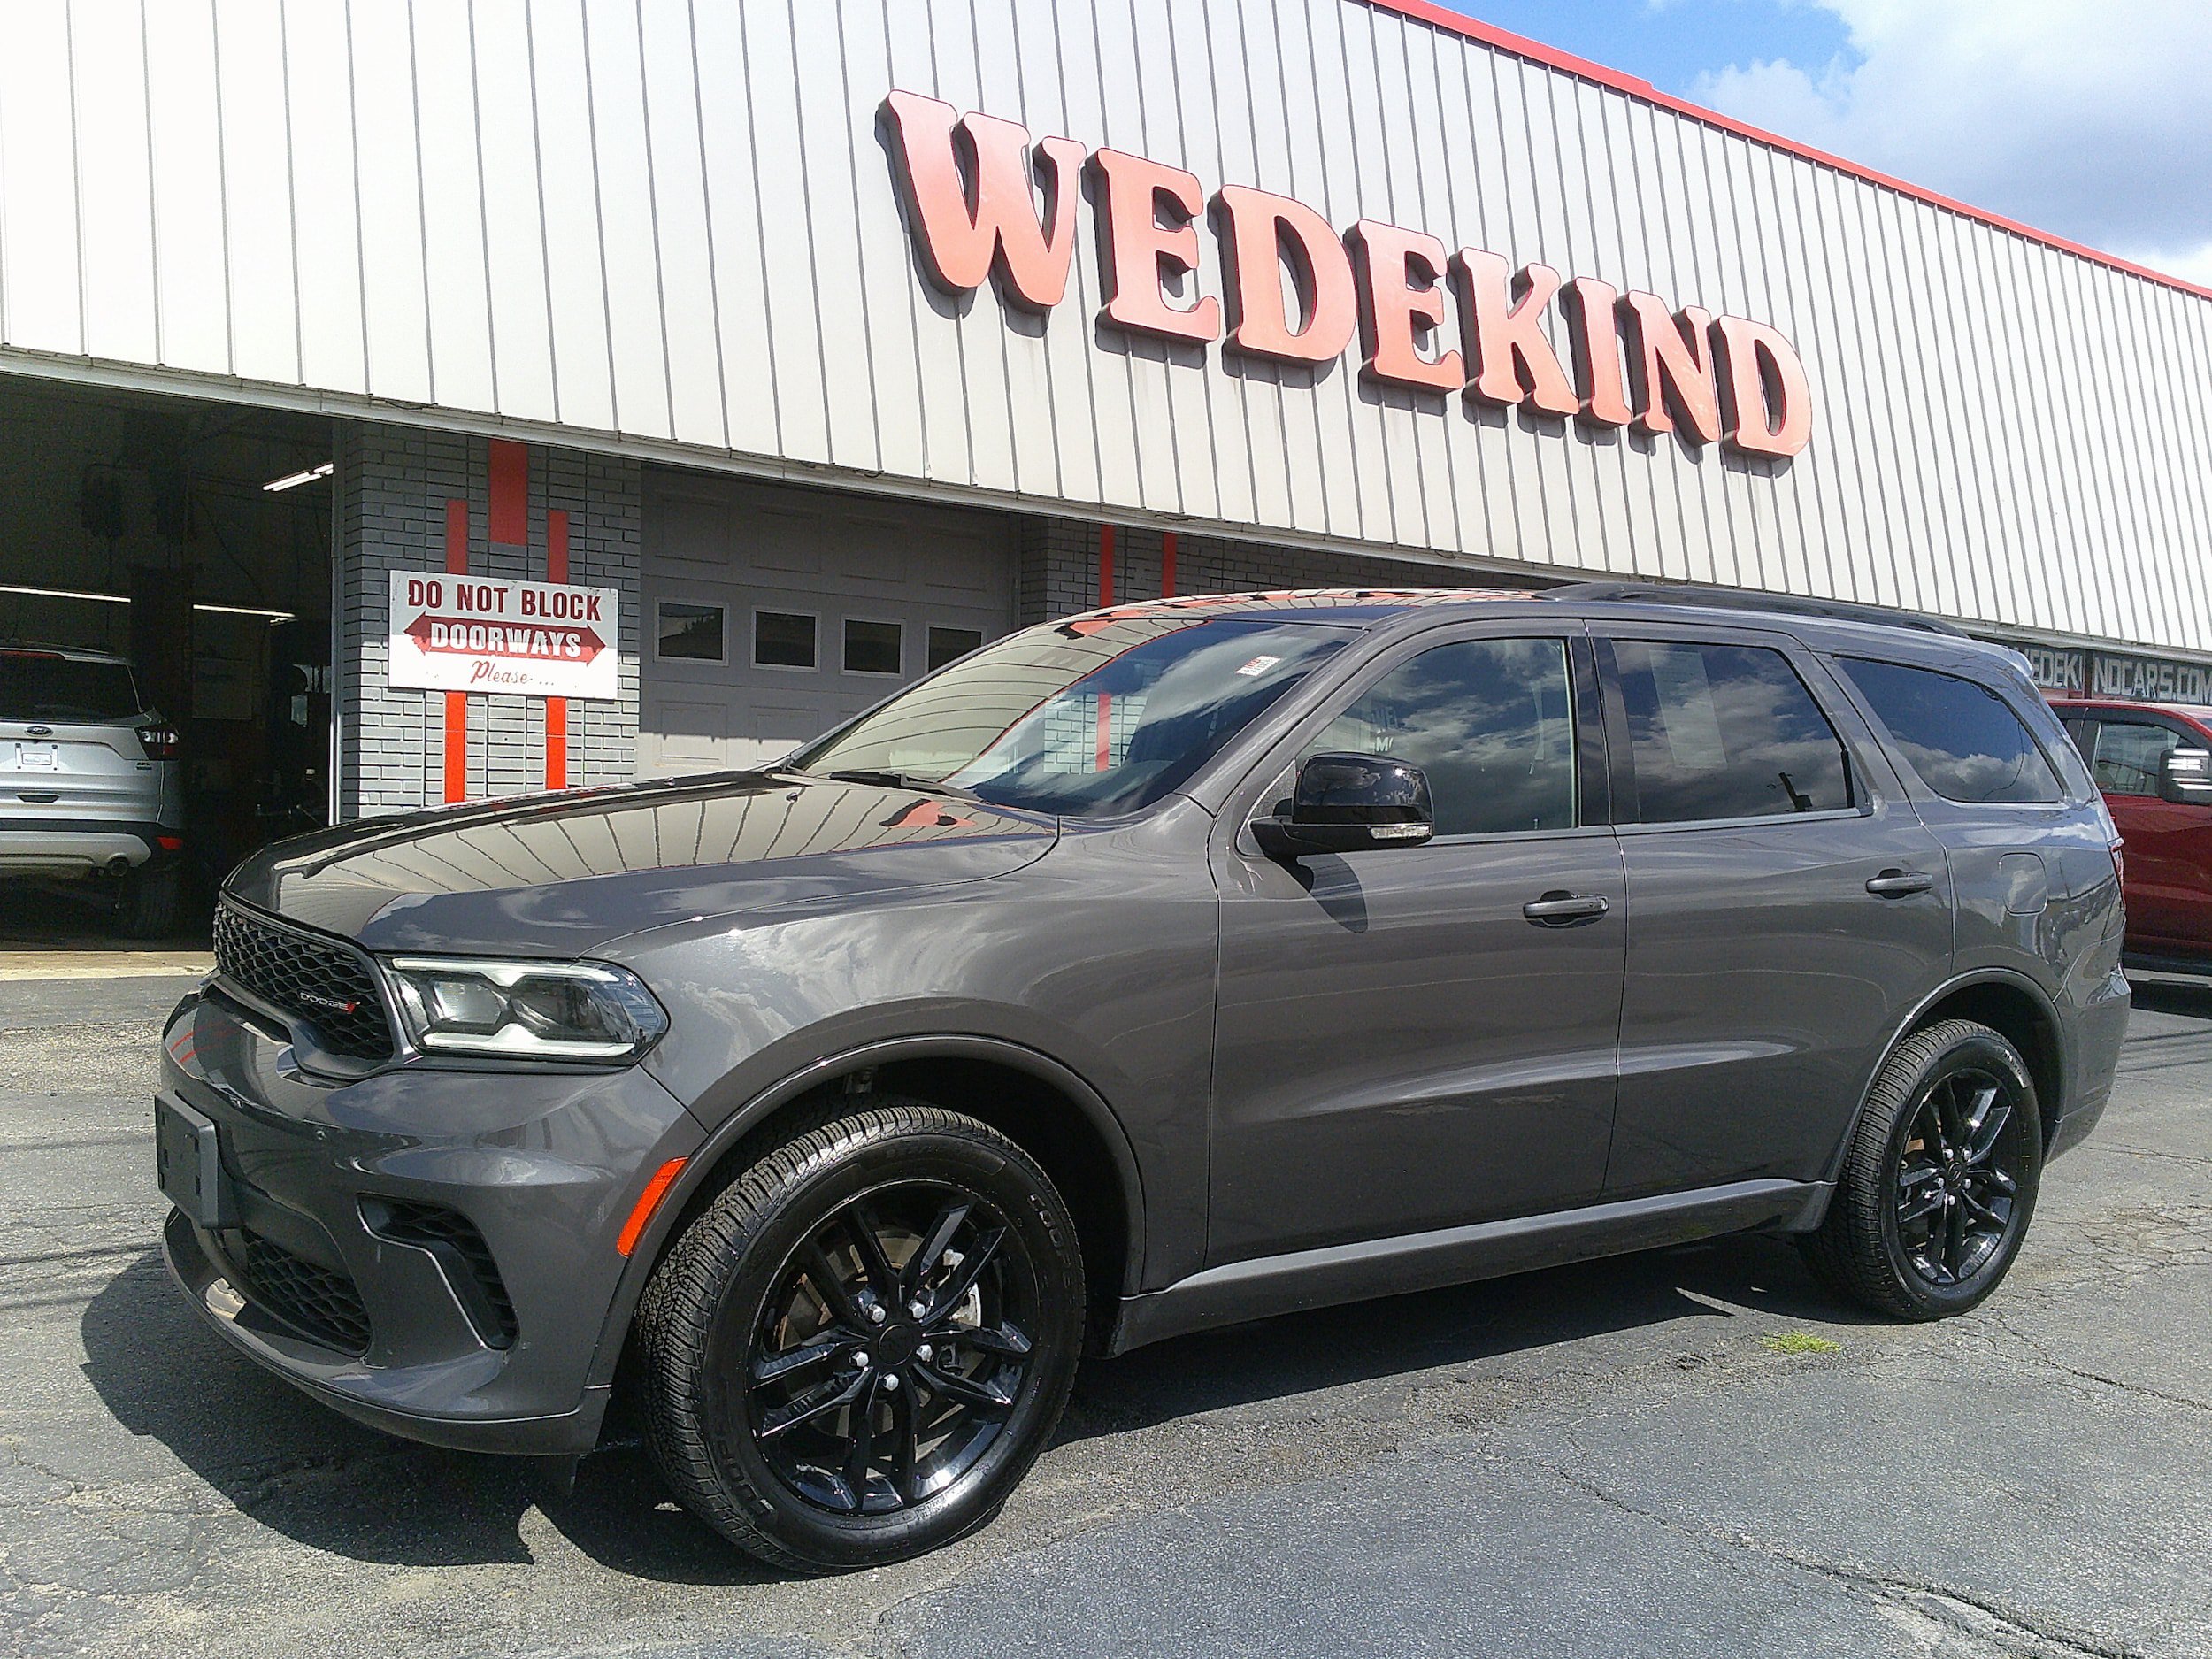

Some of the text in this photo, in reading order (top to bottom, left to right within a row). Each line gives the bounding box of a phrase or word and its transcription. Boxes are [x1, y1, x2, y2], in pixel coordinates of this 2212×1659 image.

[881, 89, 1812, 457] WEDEKIND
[408, 580, 602, 621] DO NOT BLOCK
[430, 622, 582, 657] DOORWAYS
[300, 991, 349, 1010] DODGE
